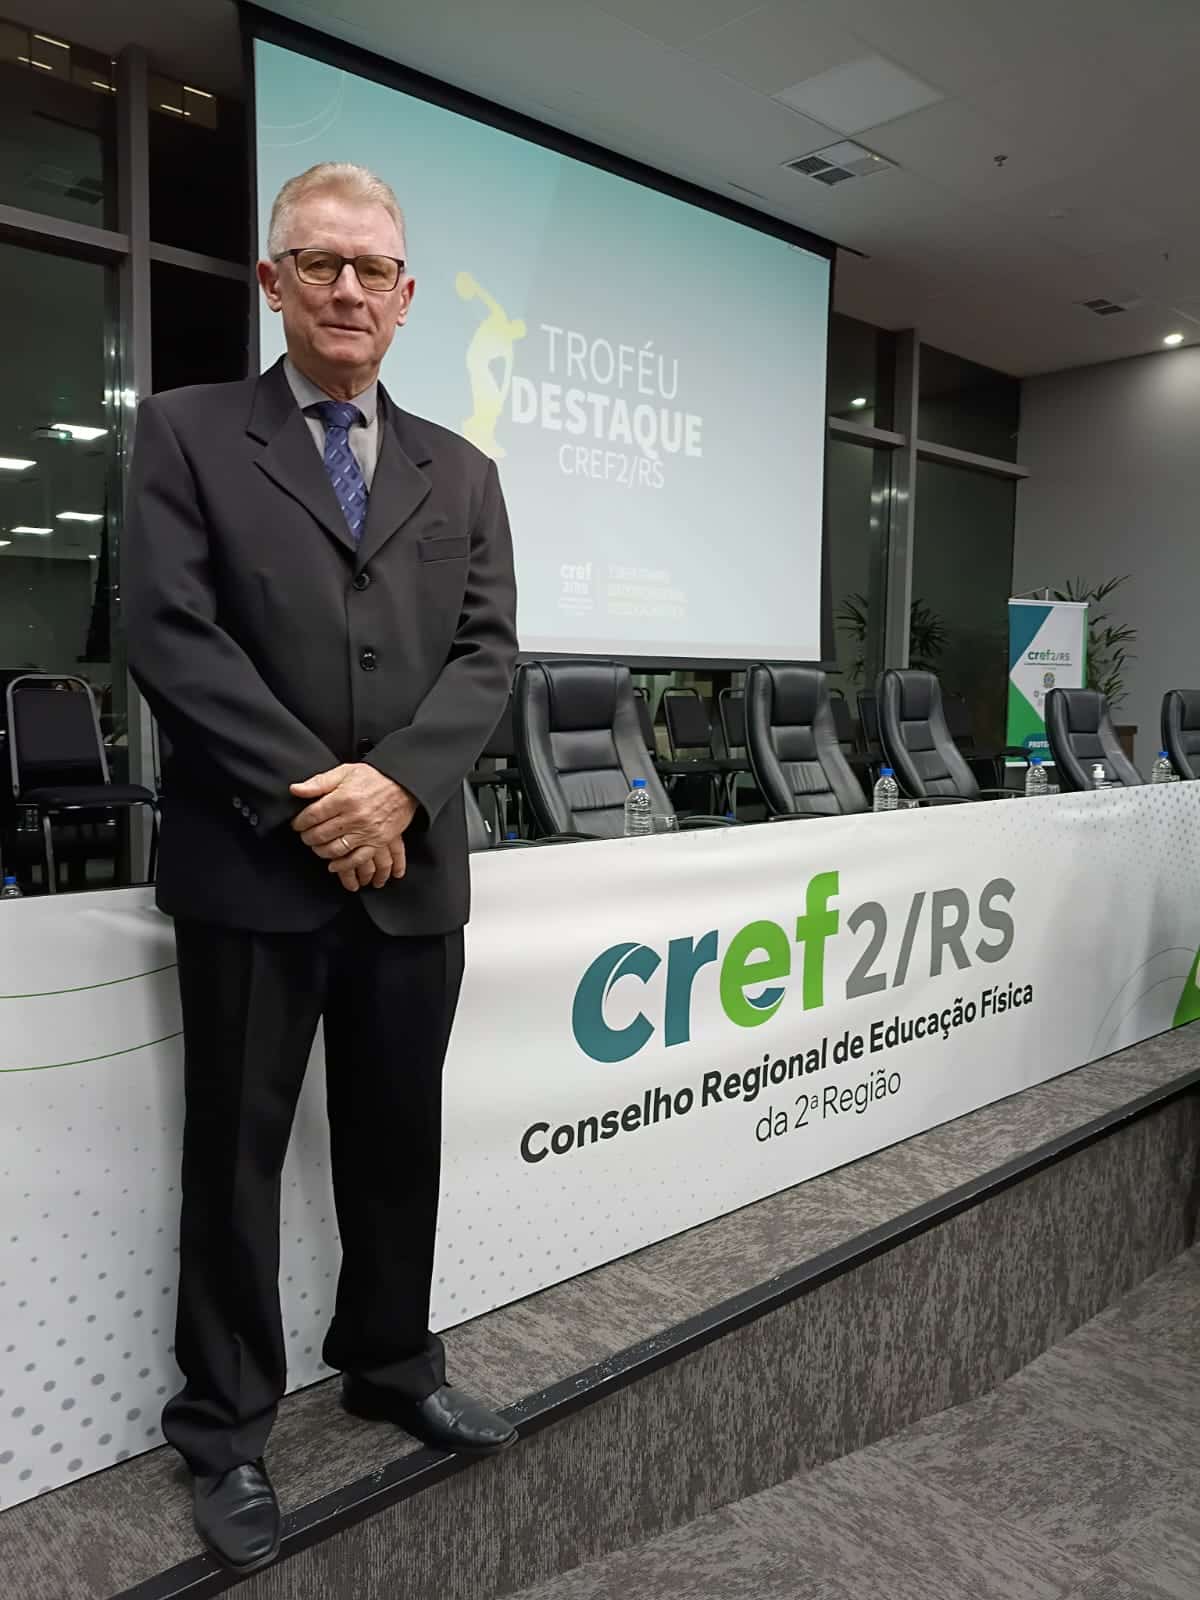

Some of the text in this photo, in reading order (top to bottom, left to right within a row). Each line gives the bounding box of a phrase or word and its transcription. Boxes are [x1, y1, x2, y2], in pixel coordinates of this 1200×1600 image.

[541, 324, 679, 399] TROFÉU
[511, 375, 703, 458] DESTAQUE
[559, 443, 665, 489] CREF2/RS
[560, 561, 592, 580] cref
[520, 981, 1033, 1163] Conselho Regional de Educação Física
[756, 1069, 901, 1142] da 2ª Região
